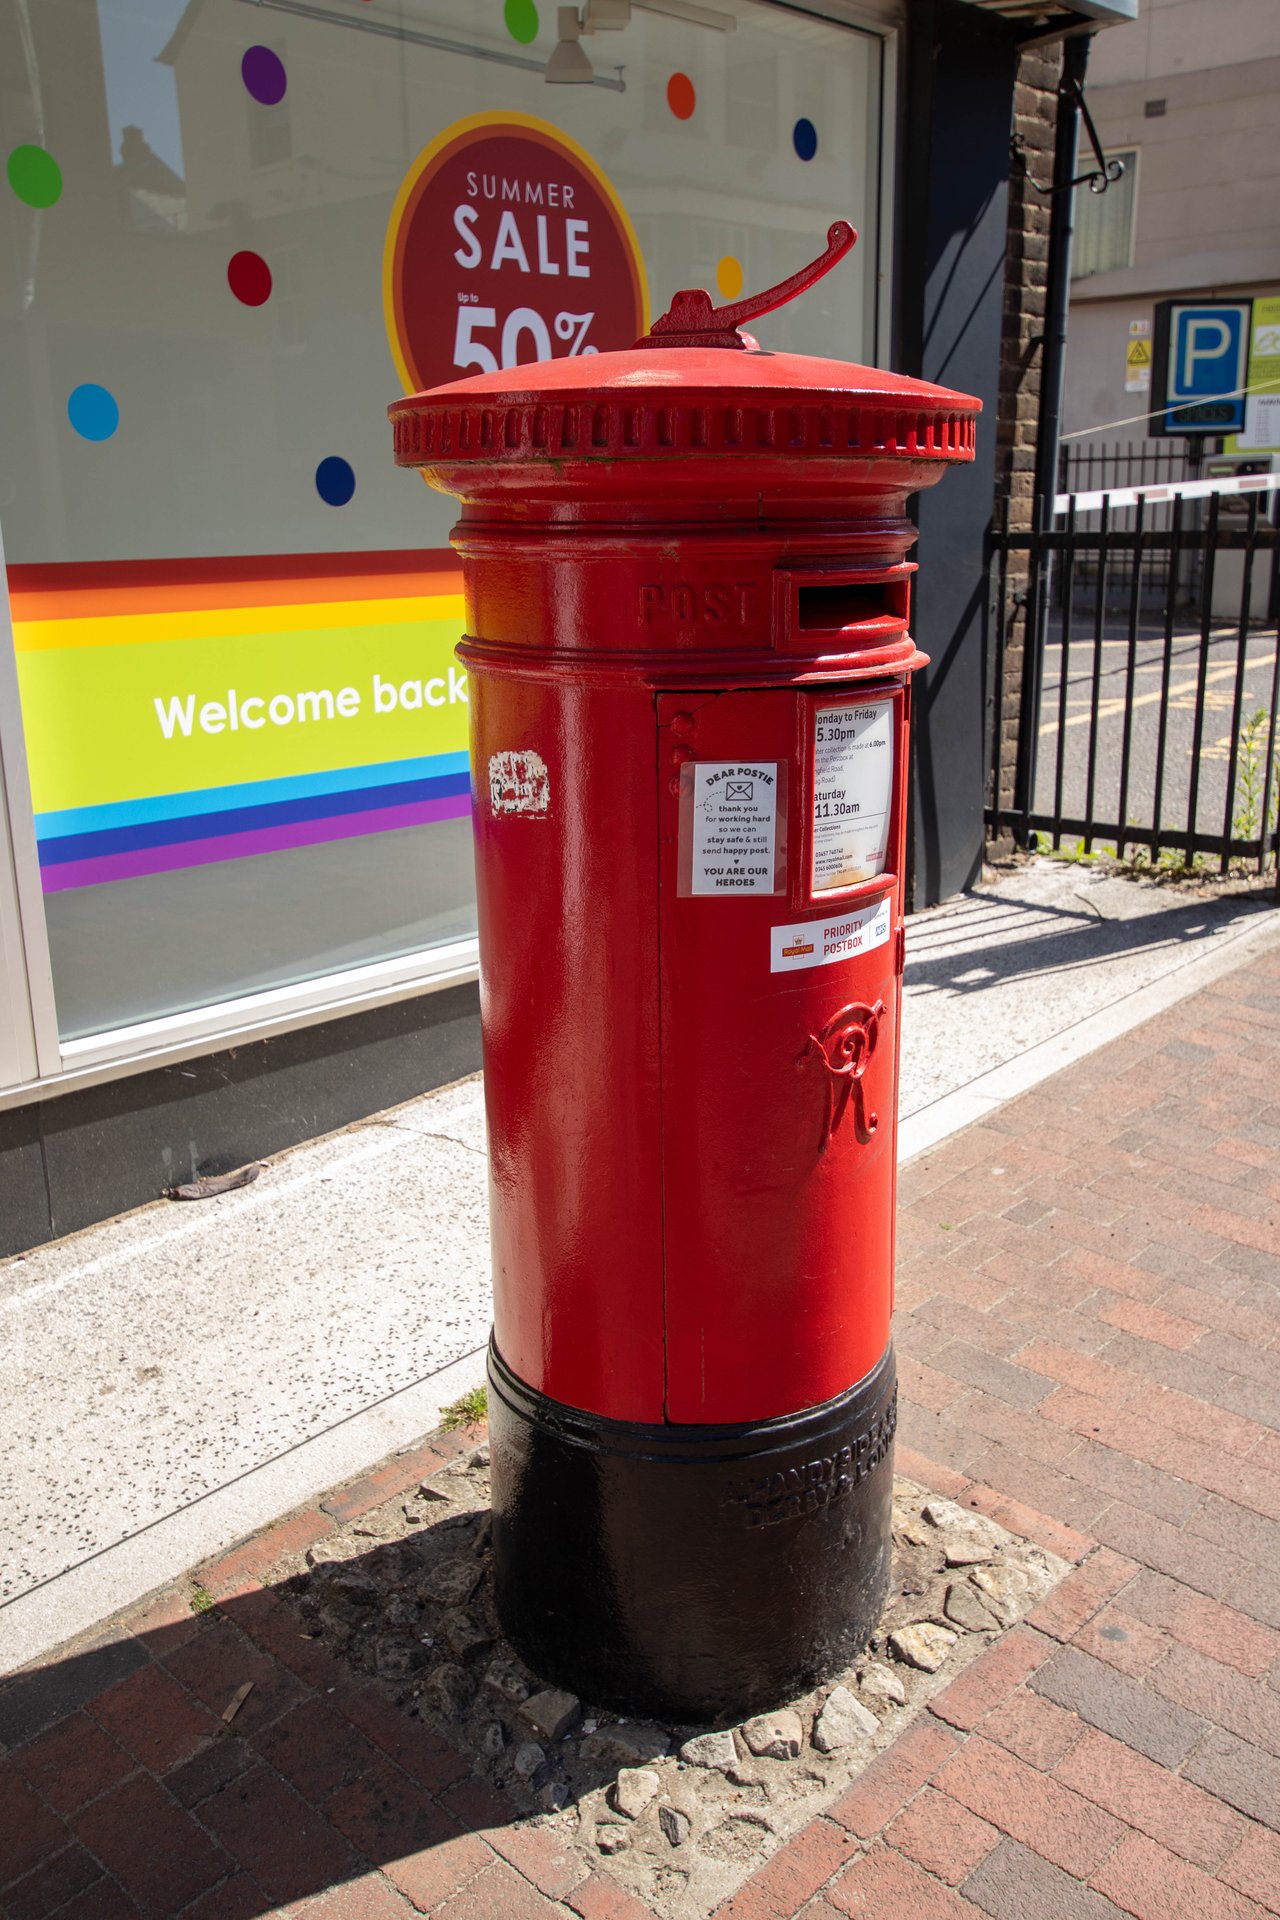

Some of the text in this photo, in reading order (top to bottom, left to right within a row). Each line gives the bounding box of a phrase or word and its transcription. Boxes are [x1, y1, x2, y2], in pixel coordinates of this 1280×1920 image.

[466, 171, 575, 209] SUMMER
[453, 204, 590, 278] SALE
[457, 292, 479, 303] Up to
[453, 305, 600, 375] 50%
[1183, 318, 1231, 388] P
[639, 583, 759, 625] POST
[153, 666, 469, 739] Welcome back
[815, 708, 877, 725] onday to Friday
[816, 726, 856, 743] 5.30pm
[705, 768, 774, 787] DEAR POSTIE
[813, 789, 846, 802] aturday
[706, 815, 771, 823] for working hard
[814, 802, 860, 819] 11.30am
[707, 836, 725, 844] stay
[702, 847, 771, 855] send happy post.
[747, 867, 768, 875] OUR
[715, 879, 755, 887] HEROES
[823, 919, 864, 940] PRIORITY
[783, 945, 813, 955] Royal Mail
[823, 935, 863, 956] POSTBOX
